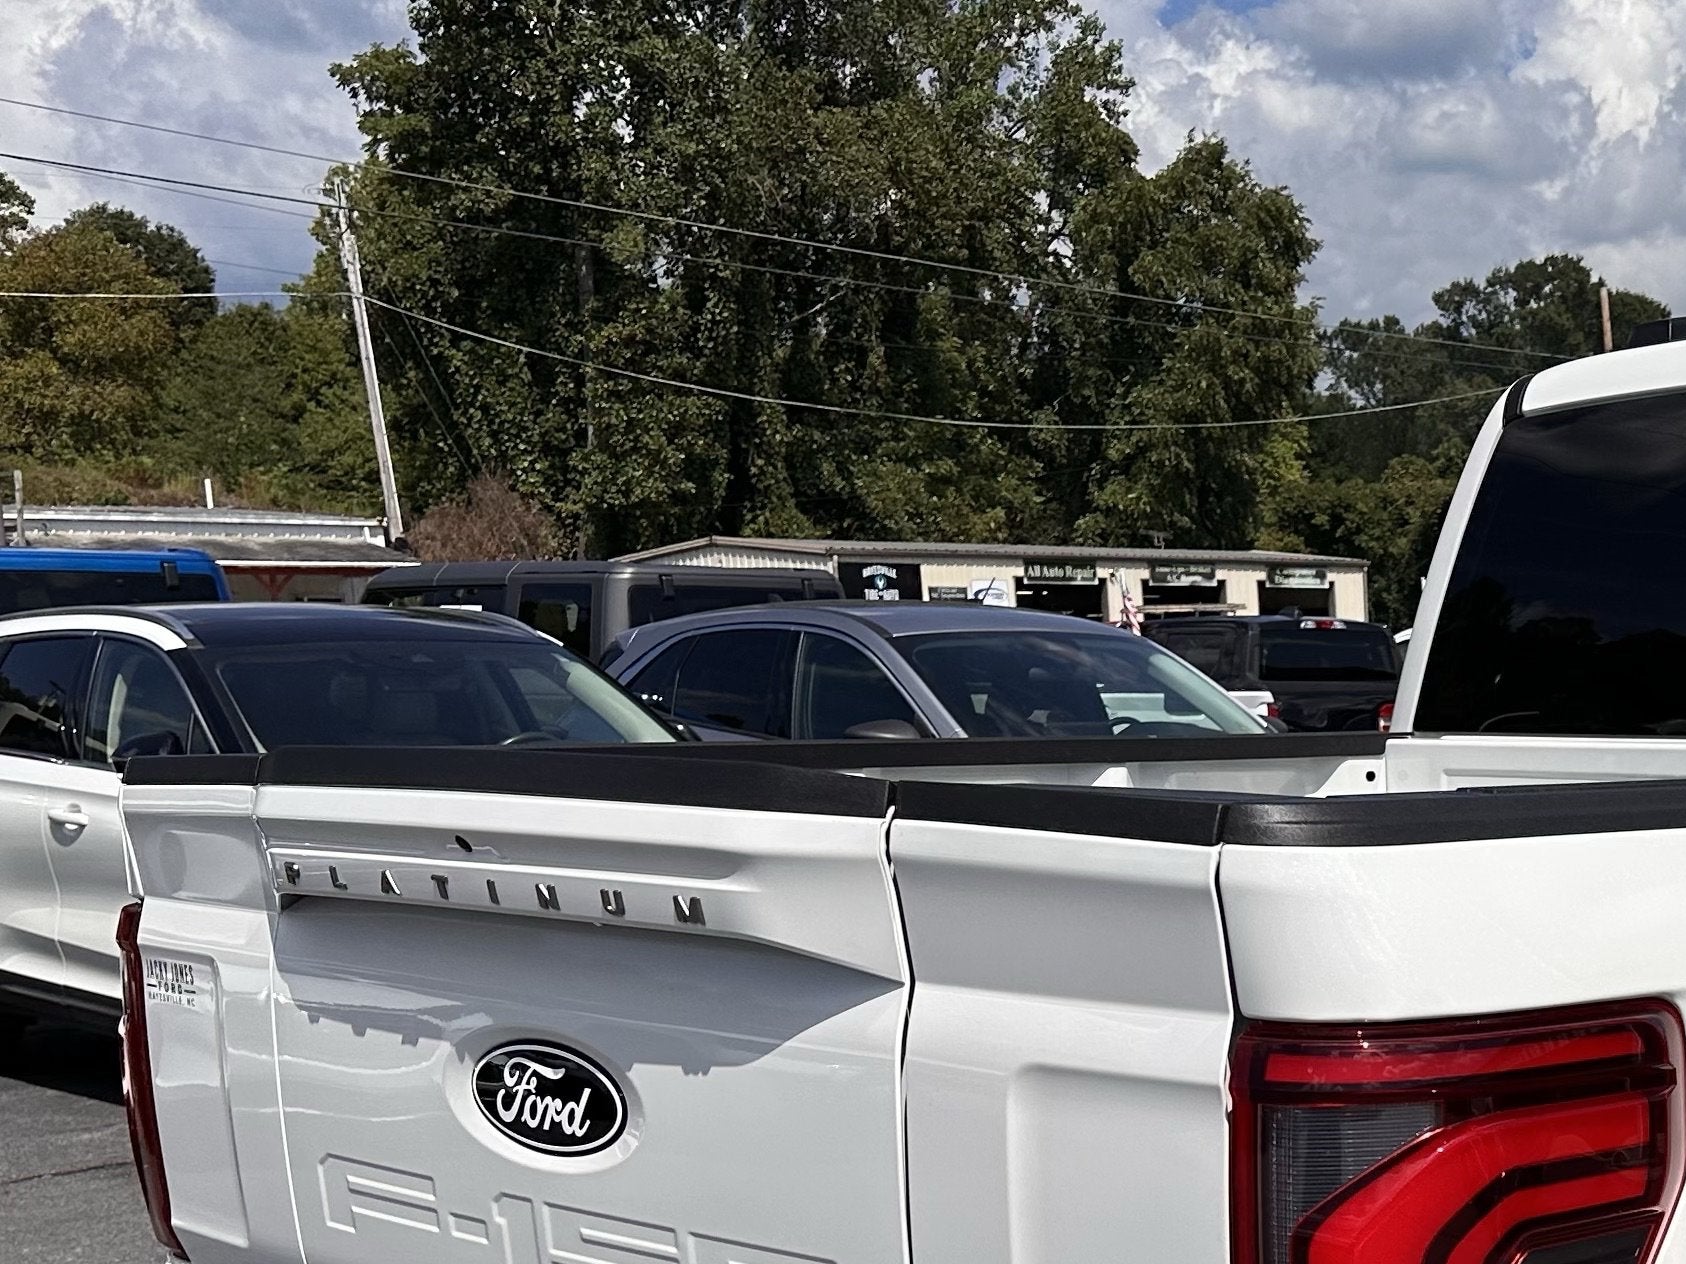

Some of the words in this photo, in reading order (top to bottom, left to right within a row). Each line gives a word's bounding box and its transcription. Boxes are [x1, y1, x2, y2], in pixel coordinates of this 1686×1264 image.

[1027, 565, 1041, 577] All
[1042, 565, 1064, 578] Auto
[1065, 565, 1095, 581] Repair
[283, 861, 707, 926] PLATINUM
[170, 962, 194, 985] JONES
[496, 1056, 592, 1138] Ford
